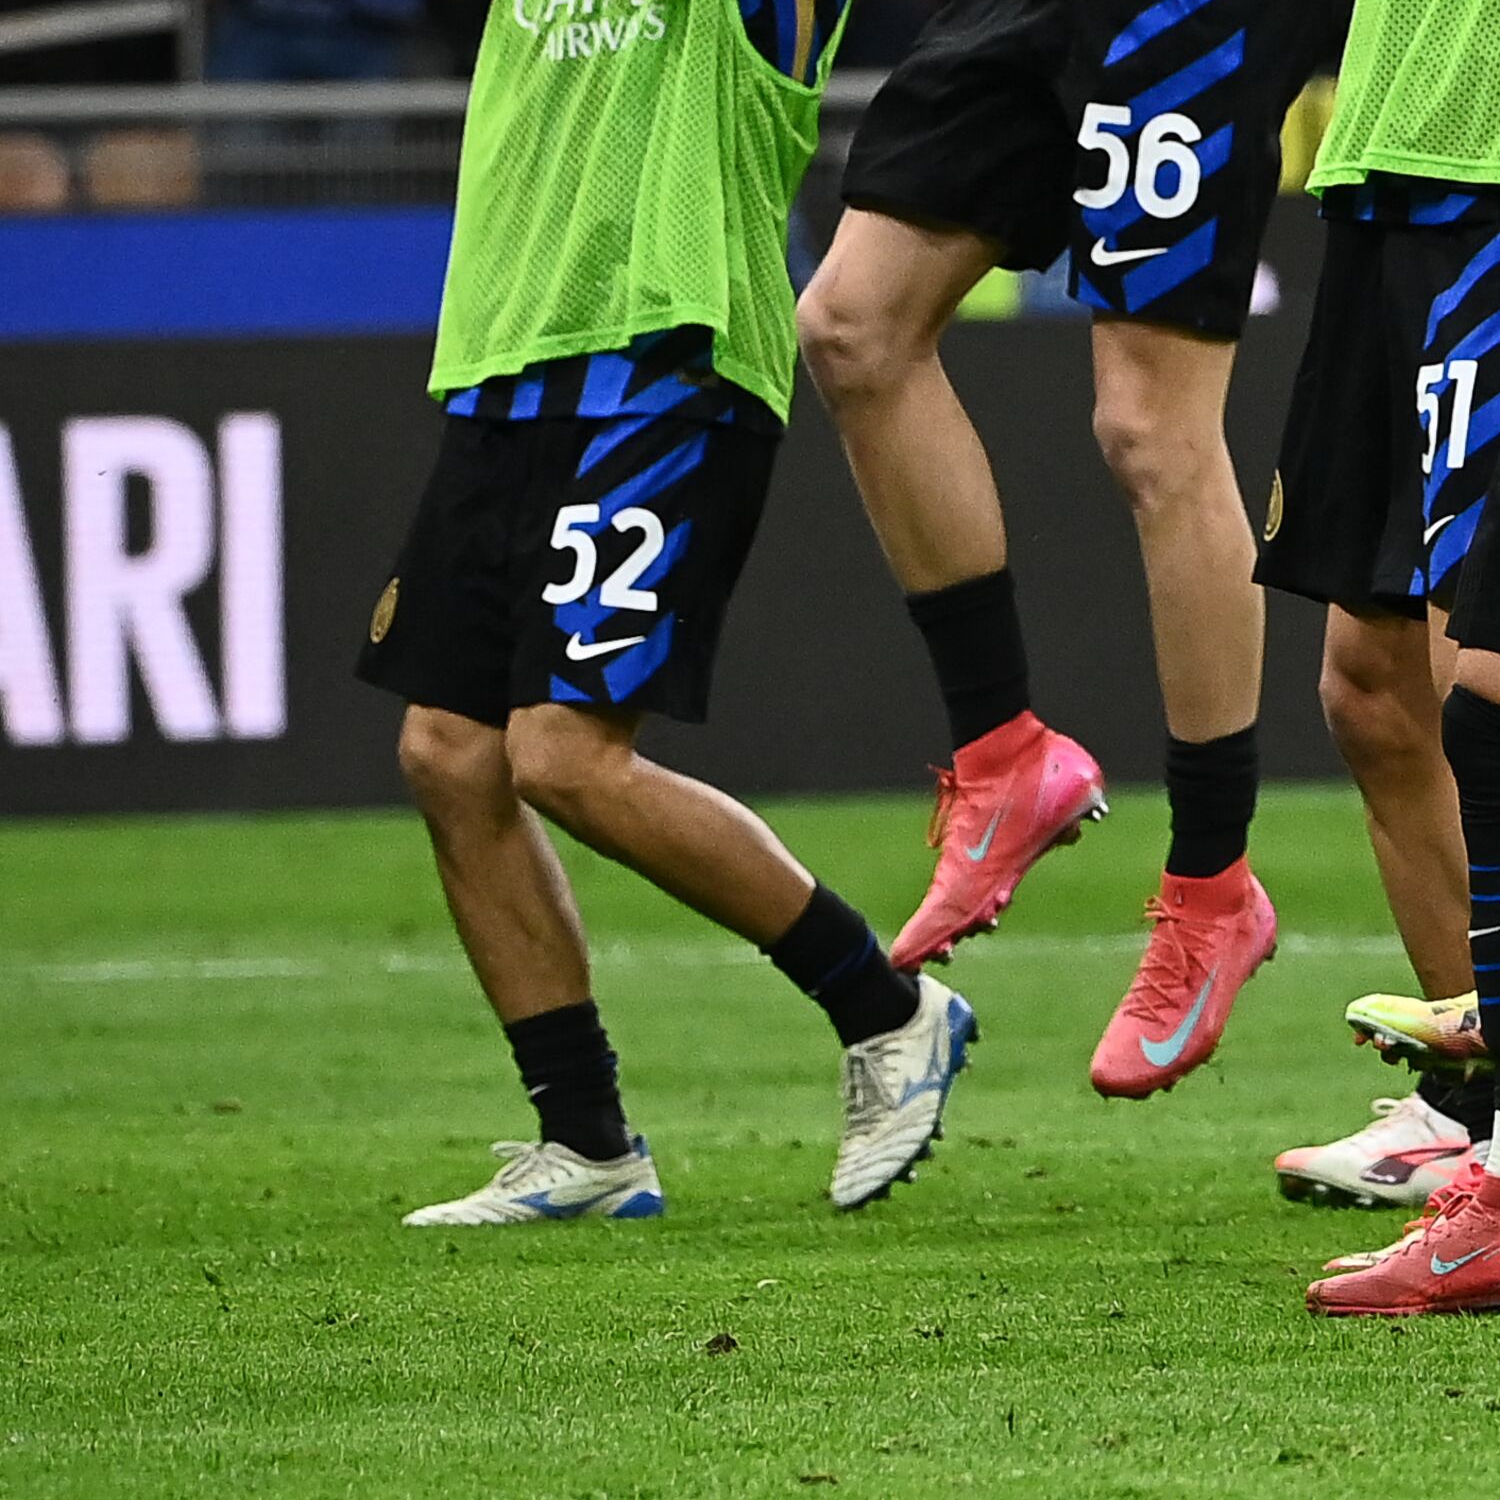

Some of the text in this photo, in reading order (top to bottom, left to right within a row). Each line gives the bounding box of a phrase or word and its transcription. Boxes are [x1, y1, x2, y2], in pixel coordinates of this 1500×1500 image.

[1073, 102, 1202, 219] 56
[1416, 359, 1478, 474] 51
[541, 503, 666, 612] 52
